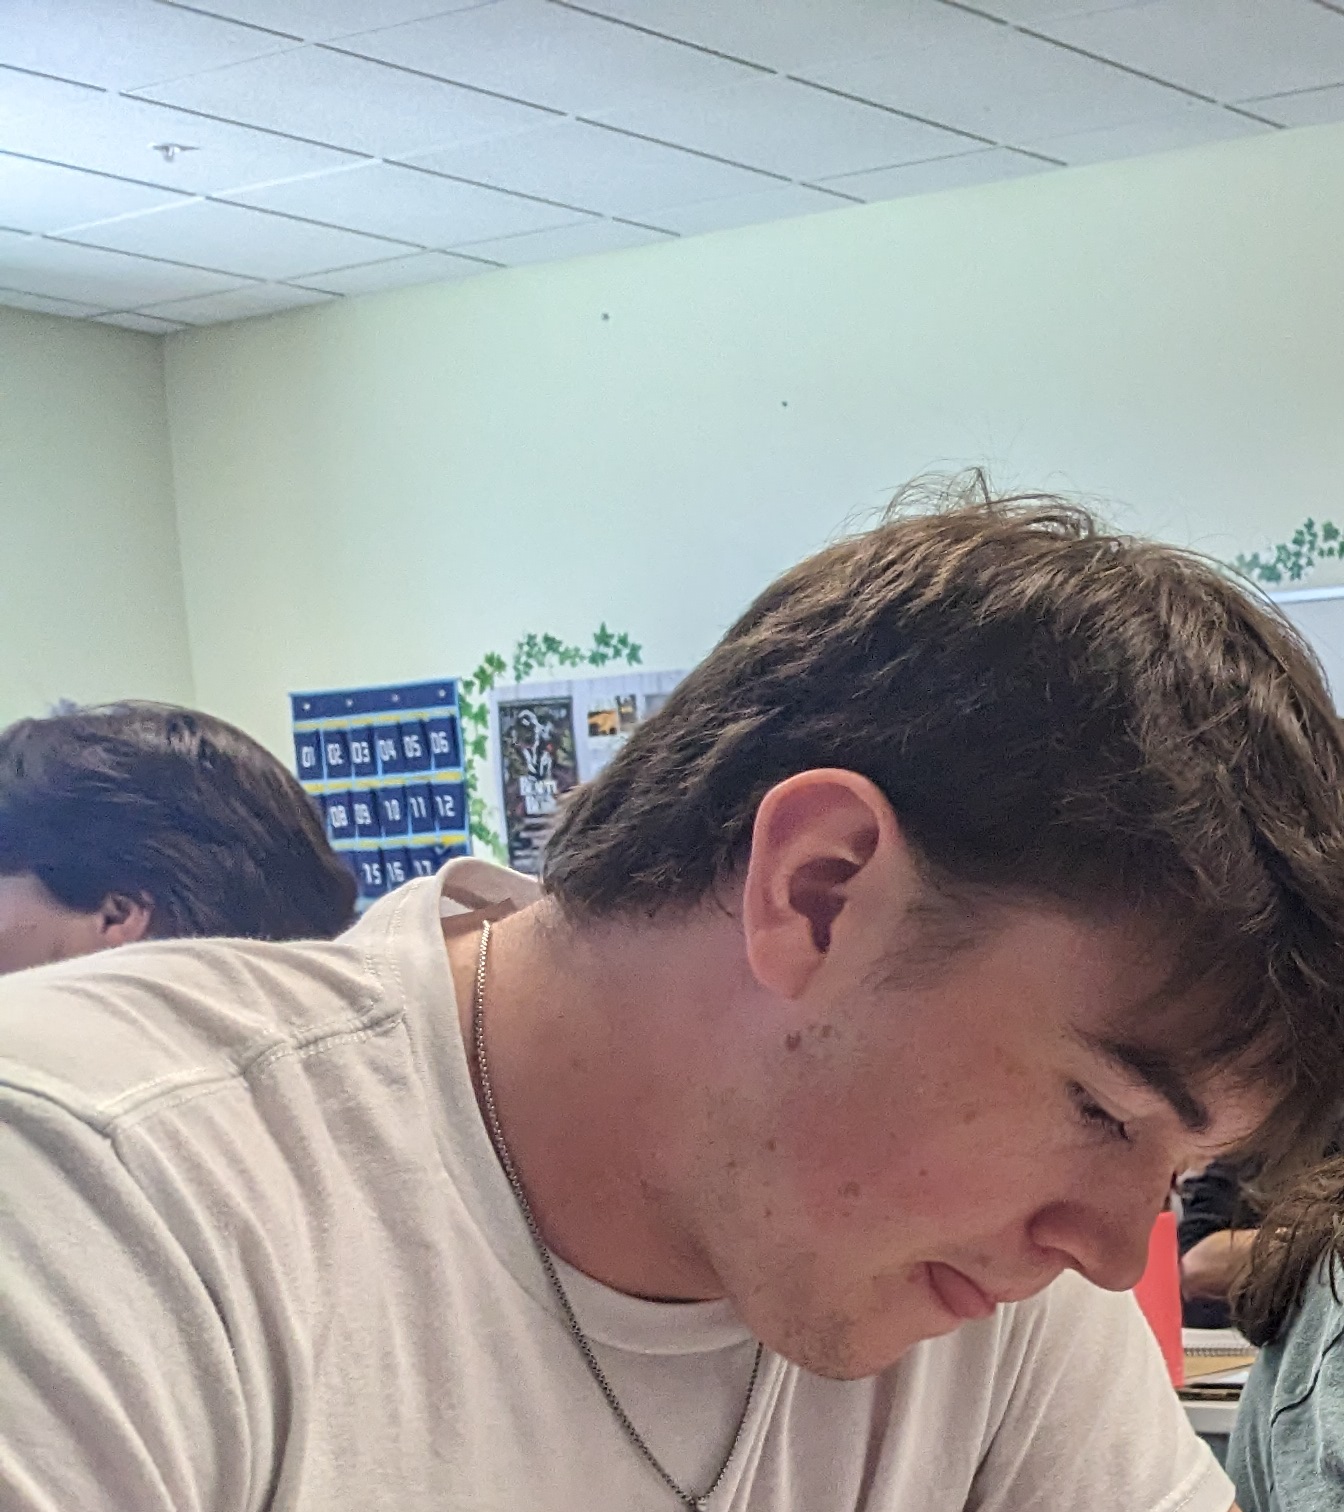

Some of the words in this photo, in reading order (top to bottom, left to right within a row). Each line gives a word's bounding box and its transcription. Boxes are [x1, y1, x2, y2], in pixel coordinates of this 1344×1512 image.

[327, 743, 344, 765] 02
[351, 742, 370, 764] 03
[379, 739, 397, 761] 04
[403, 735, 422, 757] 05
[430, 731, 449, 754] 06
[330, 805, 348, 827] 08
[384, 800, 401, 821] 10
[410, 796, 427, 818] 11
[435, 795, 455, 817] 12
[362, 863, 382, 885] 15
